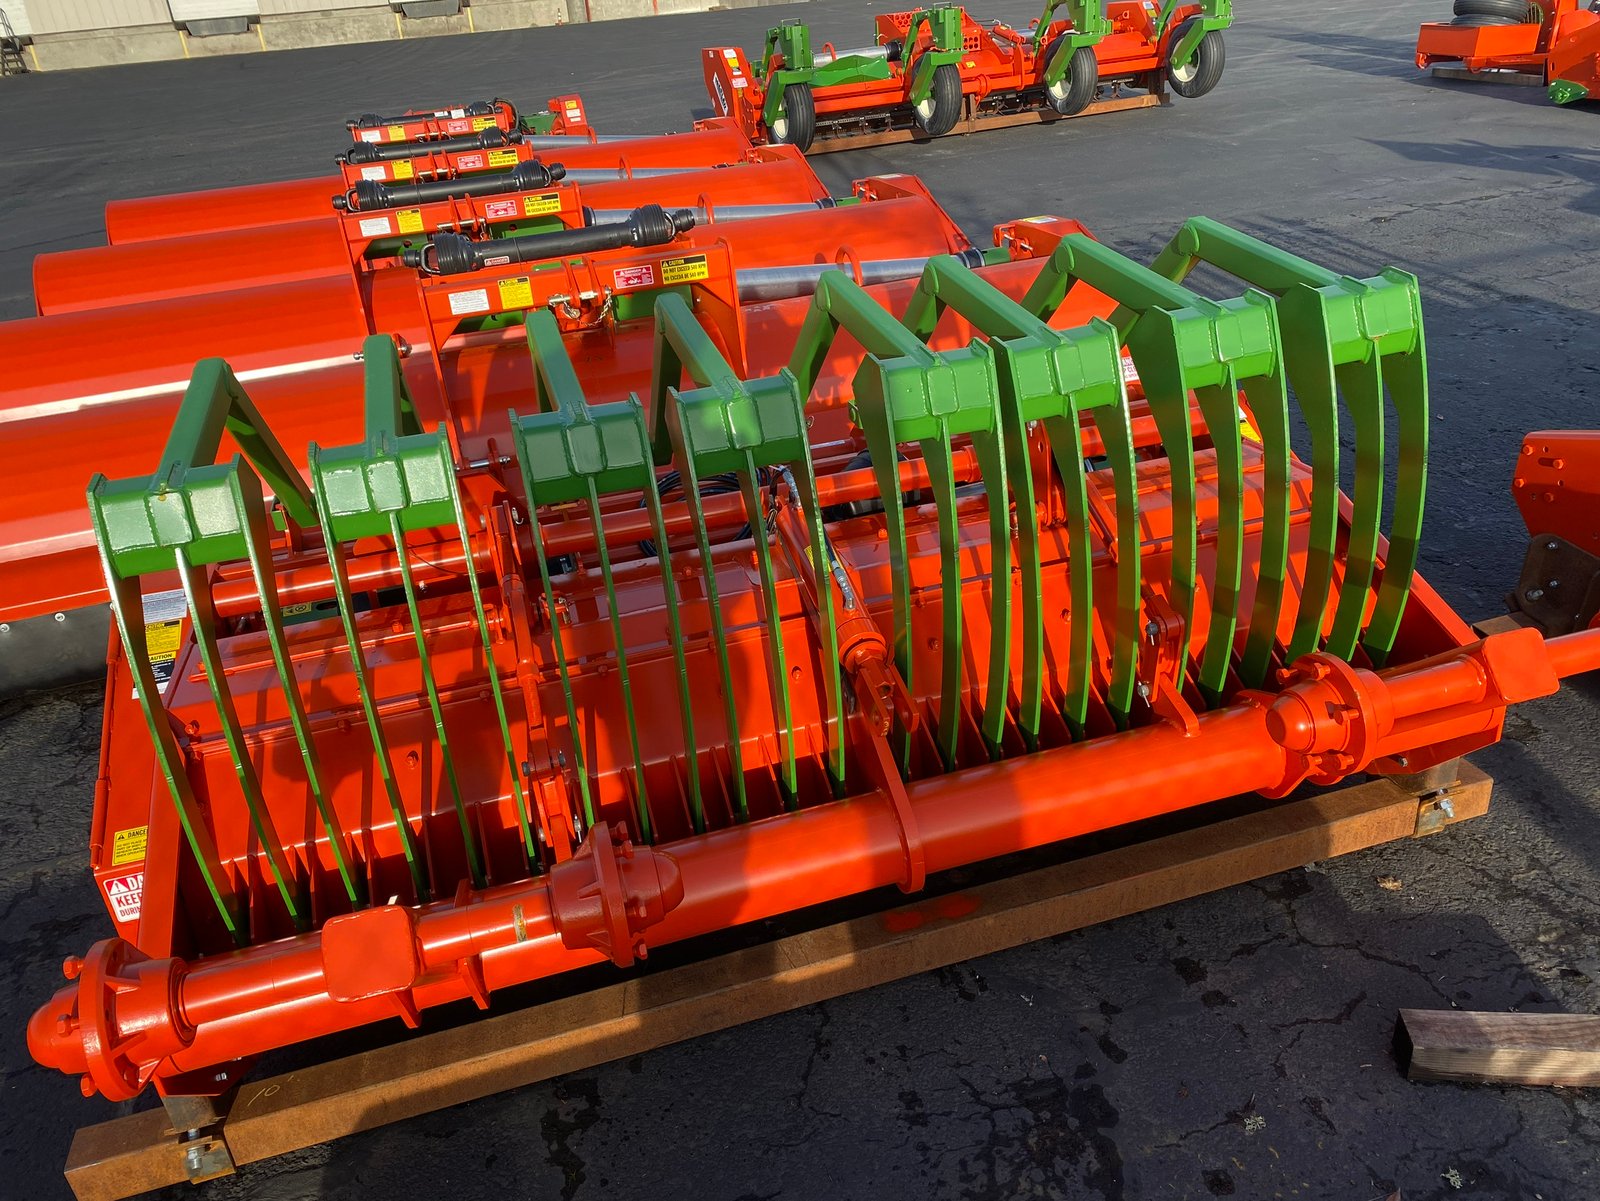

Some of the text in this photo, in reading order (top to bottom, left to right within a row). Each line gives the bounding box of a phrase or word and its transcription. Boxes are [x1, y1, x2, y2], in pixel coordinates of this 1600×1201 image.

[149, 653, 173, 661] AUTION
[127, 829, 148, 839] DANGE
[120, 906, 141, 917] DURIN
